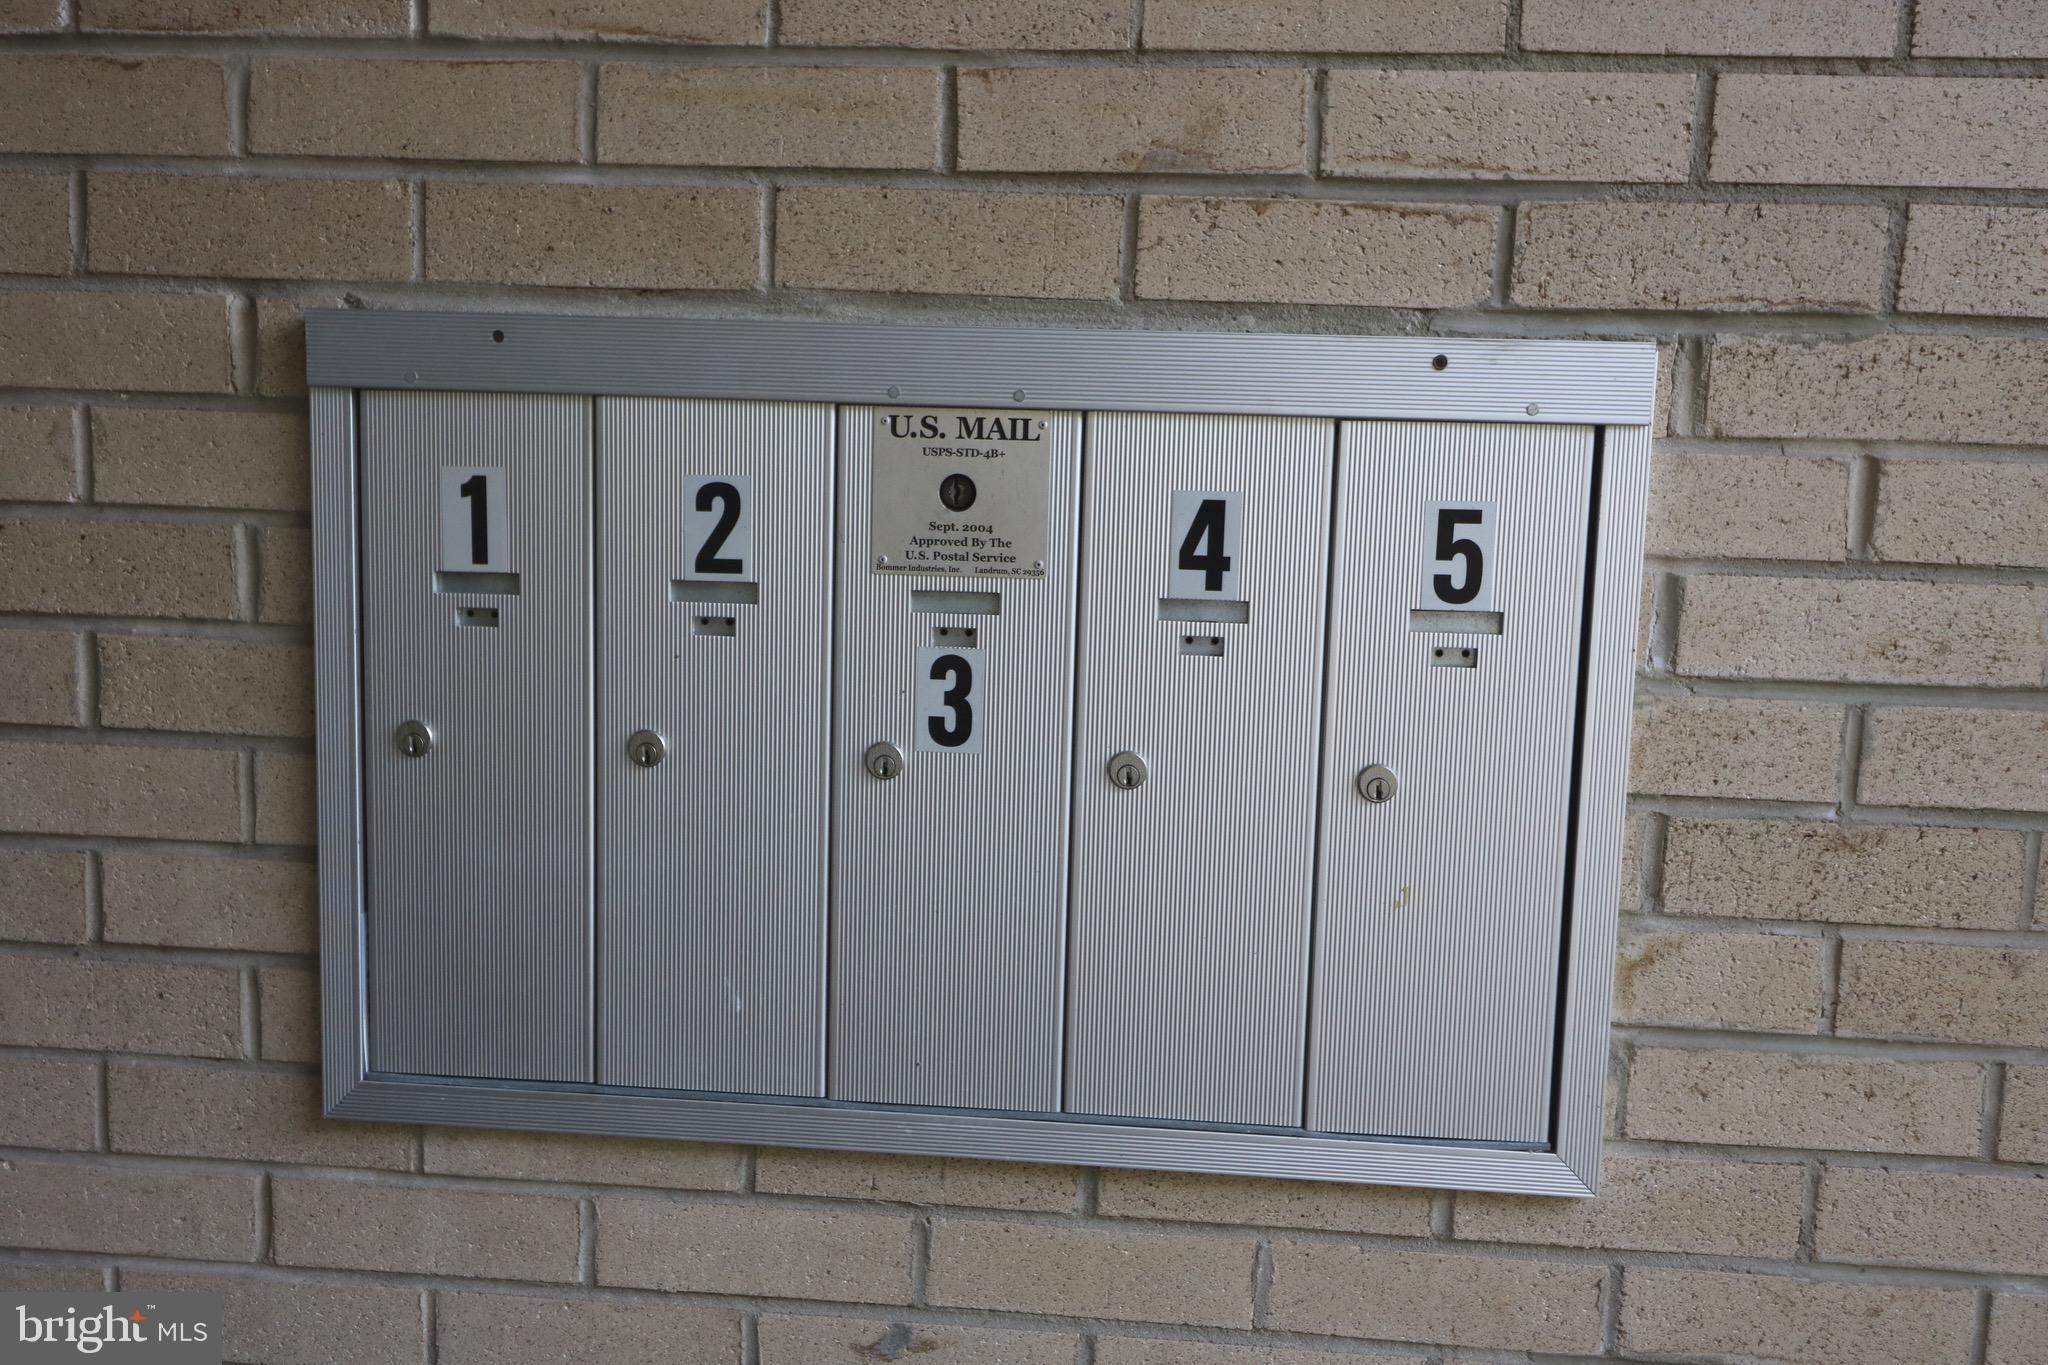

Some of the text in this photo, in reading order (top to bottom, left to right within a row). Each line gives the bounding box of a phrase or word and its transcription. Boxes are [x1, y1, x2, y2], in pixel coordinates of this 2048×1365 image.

[888, 415, 1041, 441] U.S. MAIL
[922, 447, 1006, 460] USPS-STD-4B+
[460, 475, 488, 565] 1
[694, 481, 743, 574] 2
[928, 521, 994, 535] Sept. 2004
[909, 536, 1013, 550] Approved By The
[1178, 499, 1231, 592] 4
[905, 550, 1017, 563] U.S. Postal Service
[1433, 508, 1484, 605] 5
[876, 563, 908, 572] Bommer
[908, 564, 947, 574] Industries,
[974, 566, 1045, 577] Landrum, SC 29356
[928, 654, 973, 747] 3
